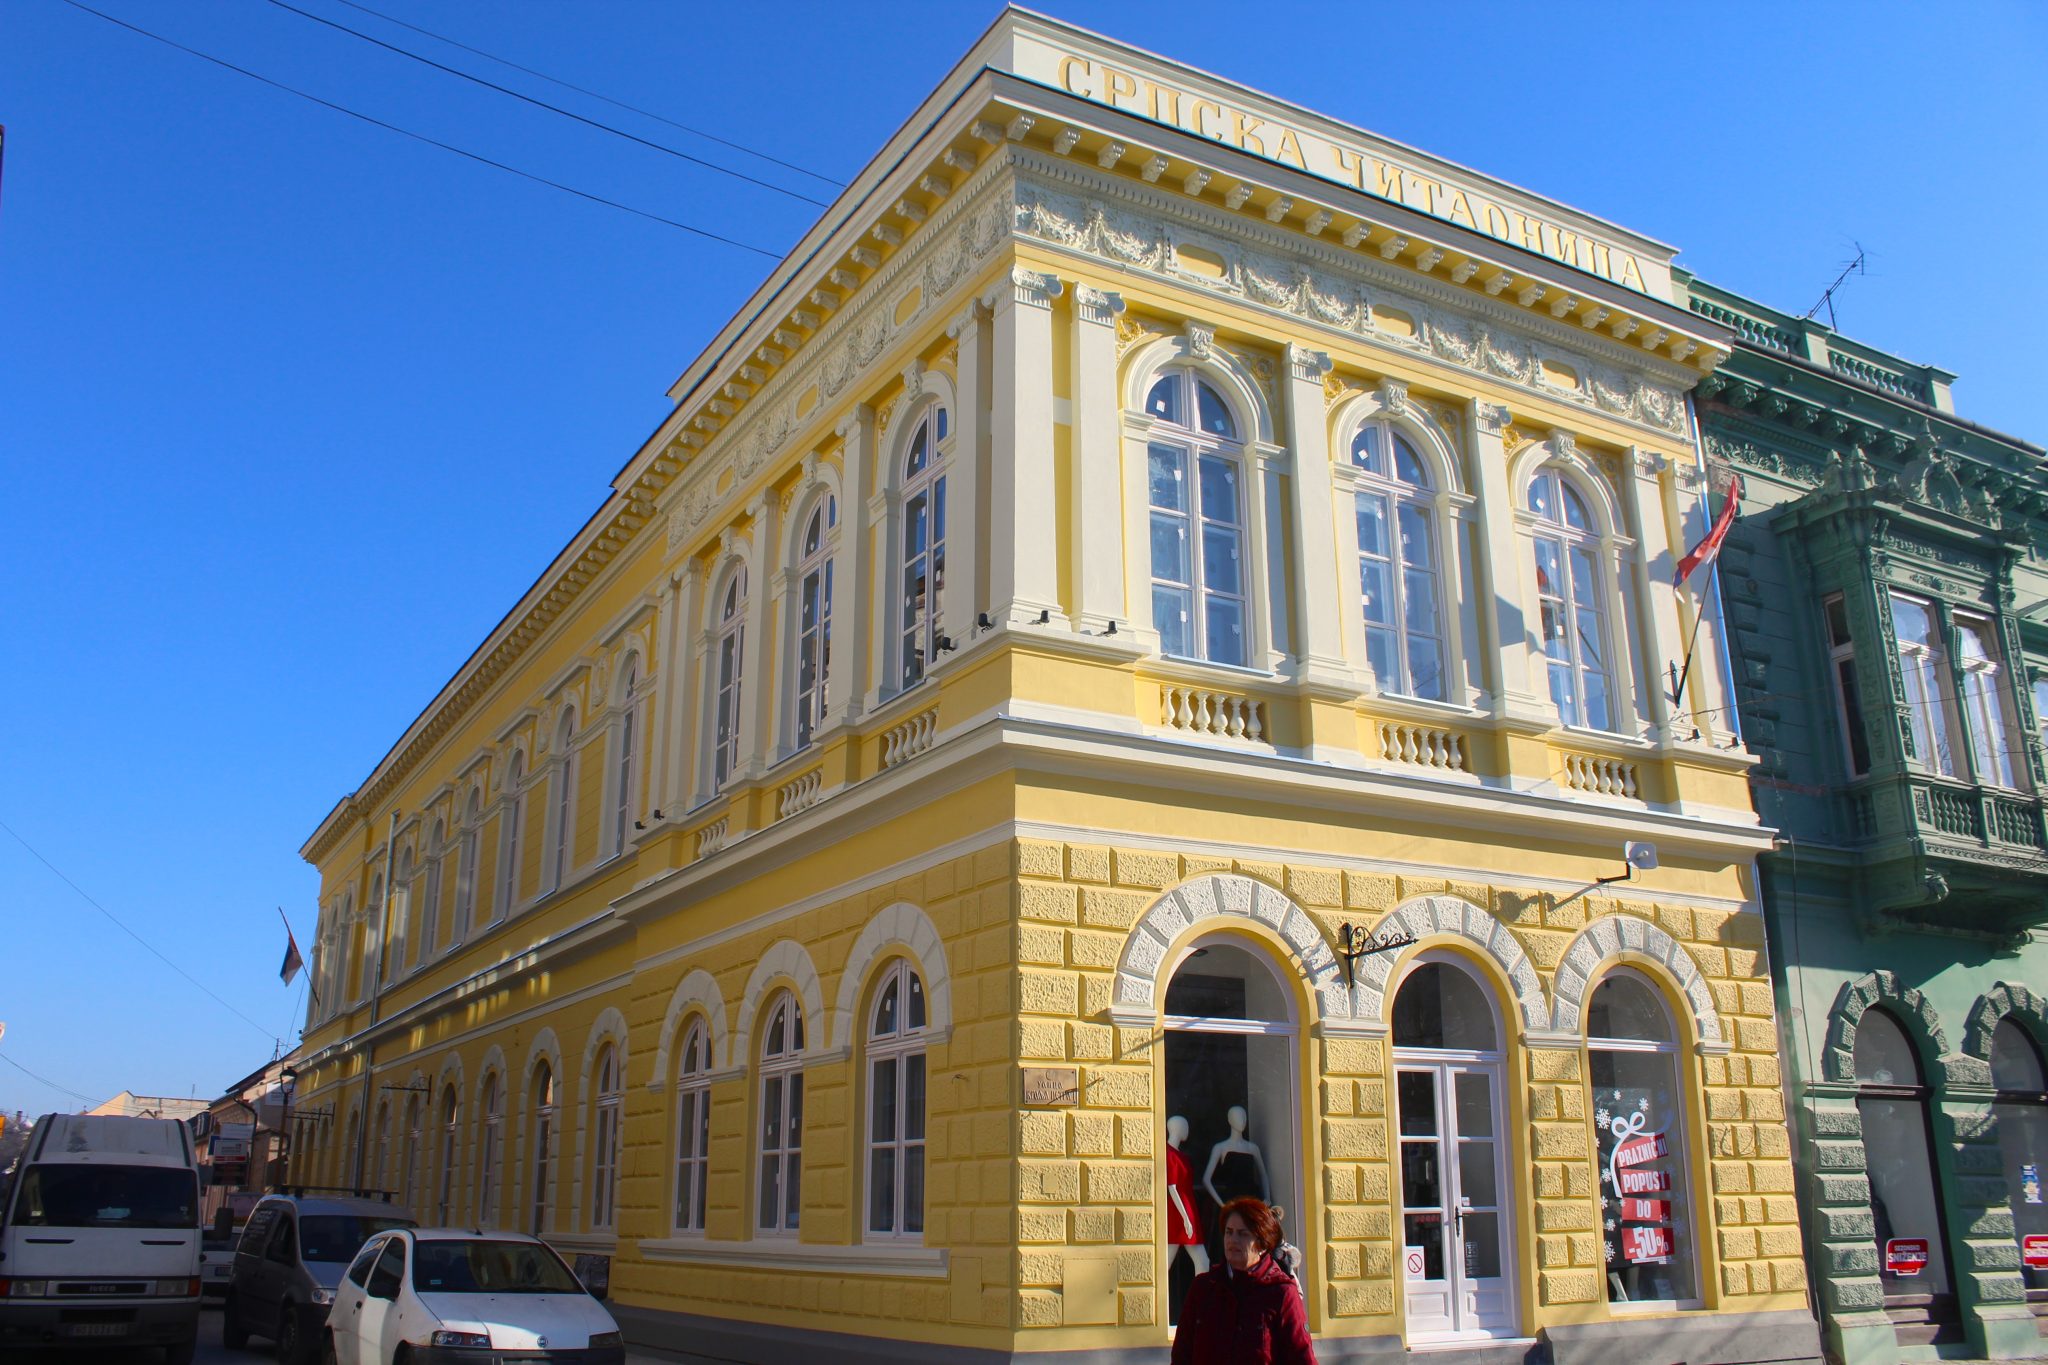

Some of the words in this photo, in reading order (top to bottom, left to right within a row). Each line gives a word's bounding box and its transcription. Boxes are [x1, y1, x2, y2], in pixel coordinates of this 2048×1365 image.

[1058, 55, 1308, 170] СРПСКА
[1329, 145, 1648, 293] ЧИТАОНИЦА
[1618, 1137, 1668, 1168] PRAZNIČNI
[1623, 1171, 1666, 1193] POPUST
[1636, 1199, 1652, 1218] DO
[1629, 1226, 1669, 1259] -50%
[1888, 1251, 1927, 1263] SNIŽENJE
